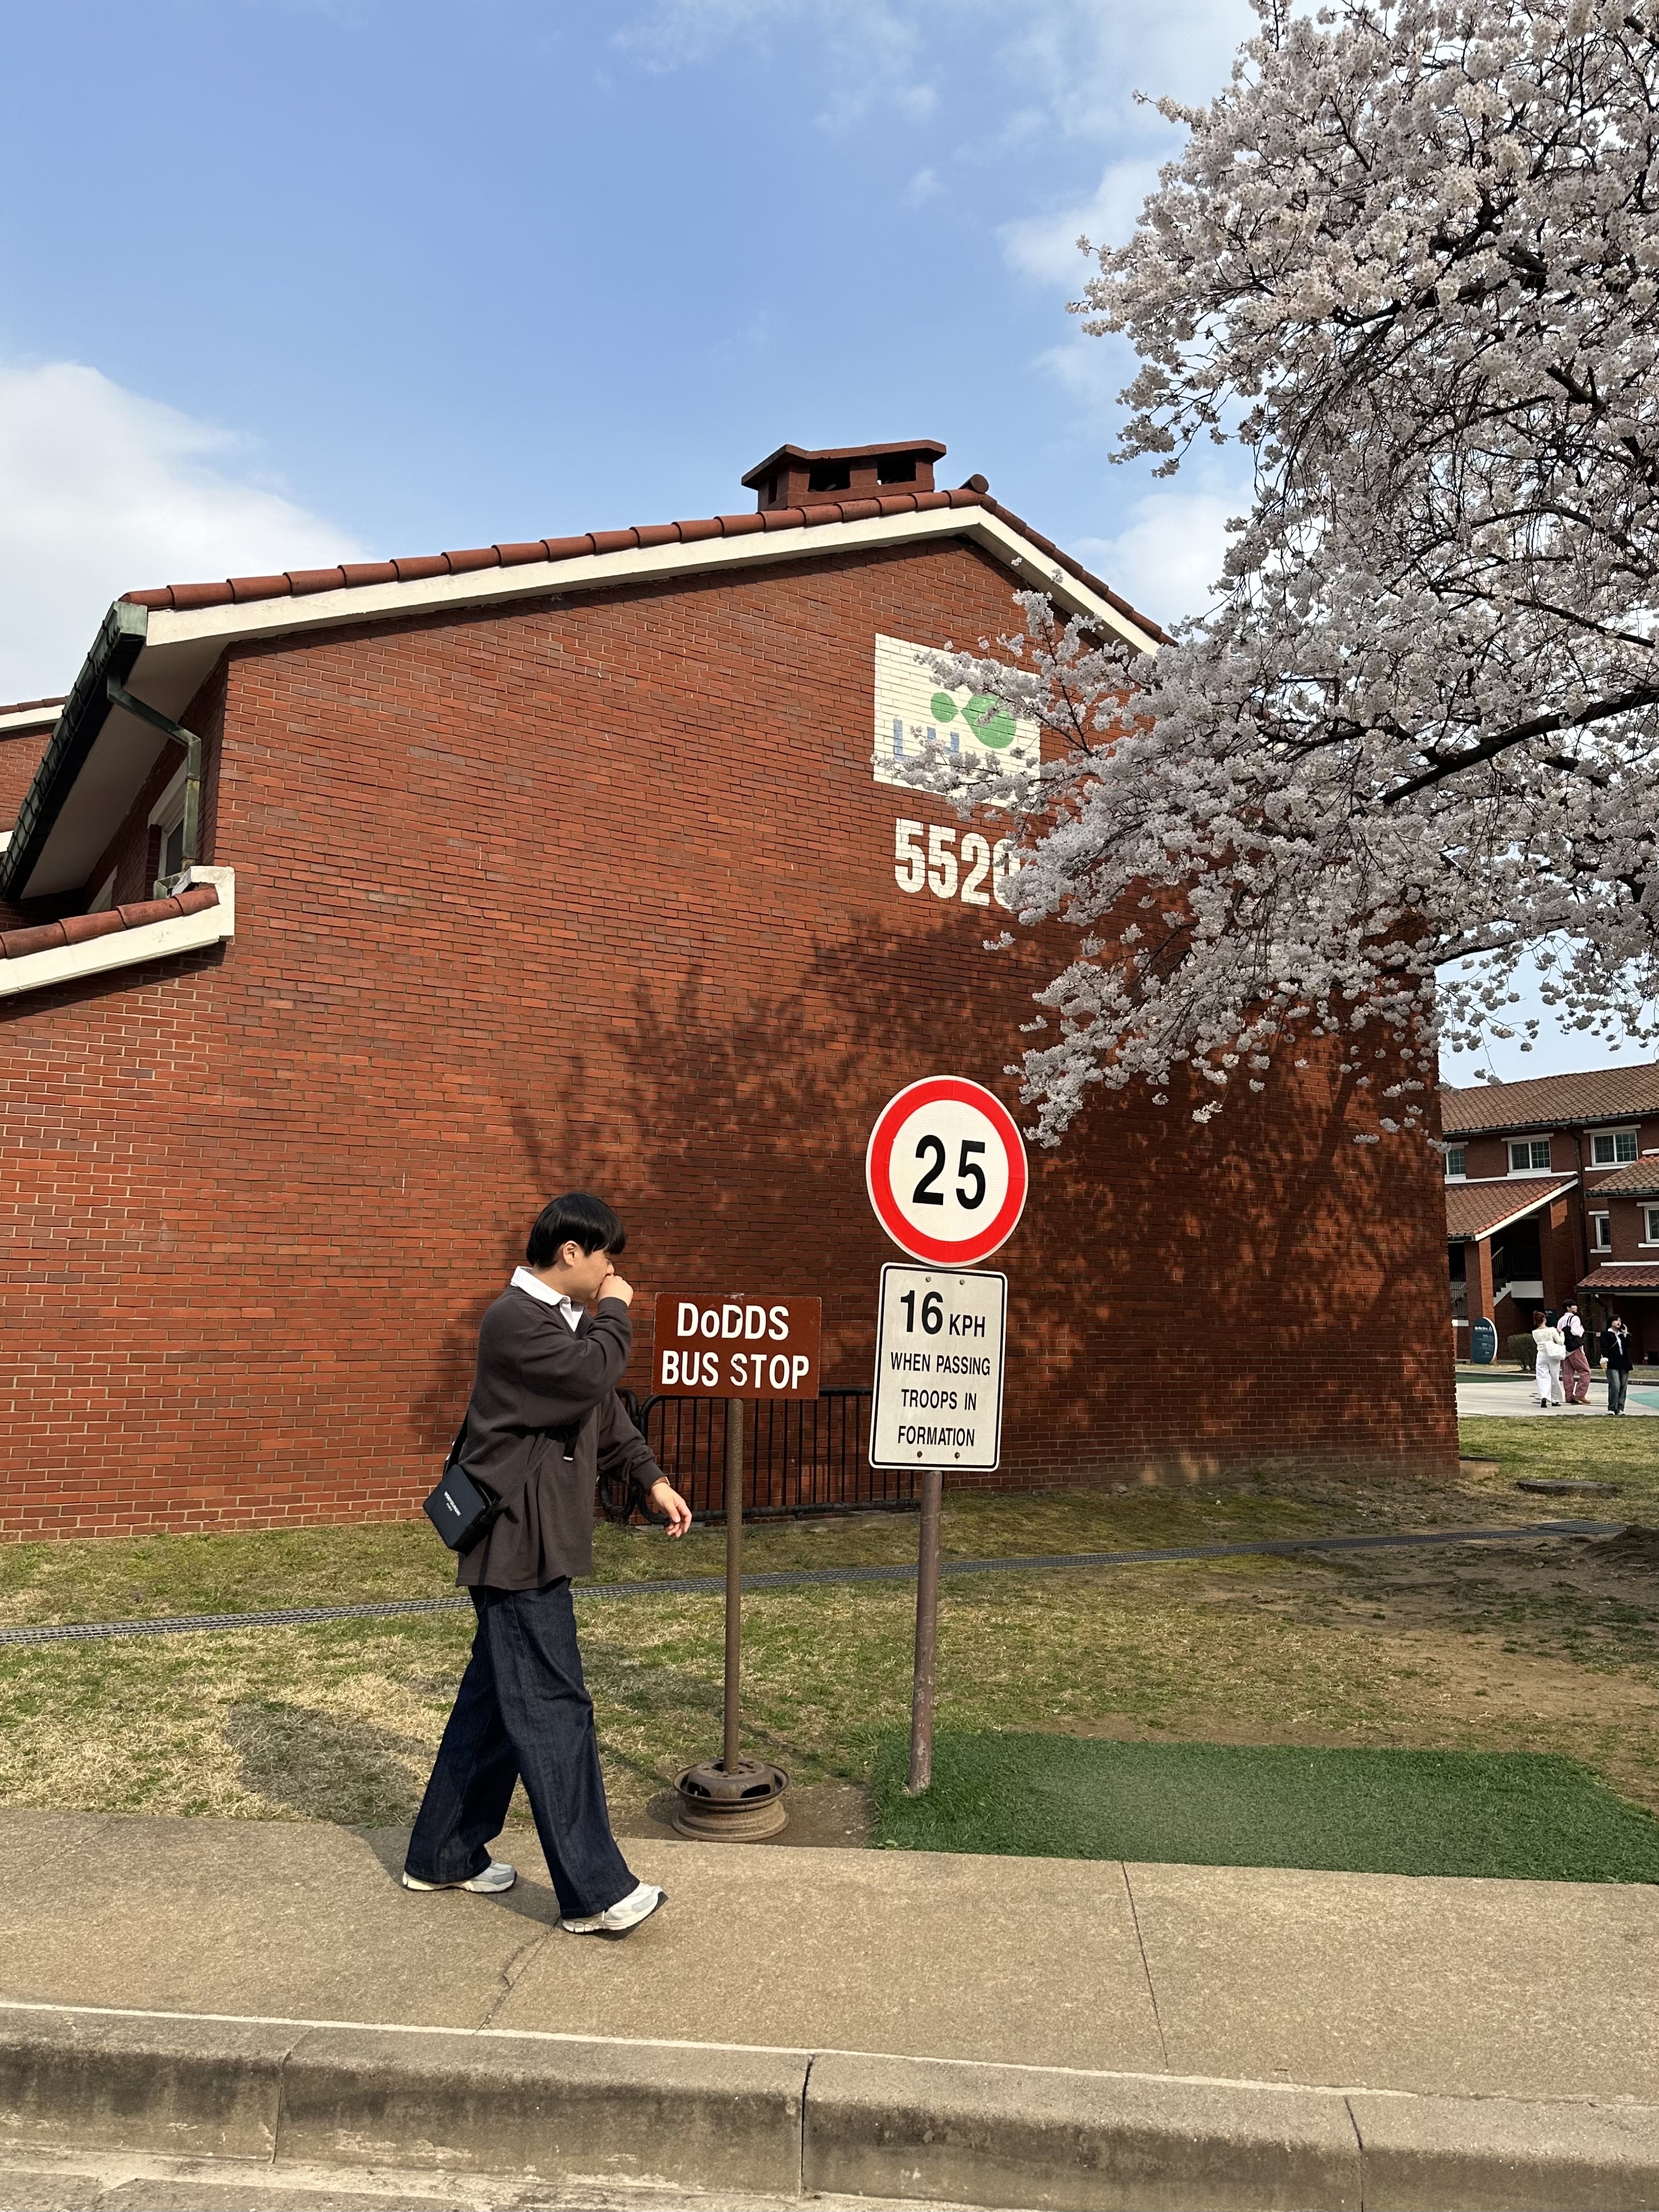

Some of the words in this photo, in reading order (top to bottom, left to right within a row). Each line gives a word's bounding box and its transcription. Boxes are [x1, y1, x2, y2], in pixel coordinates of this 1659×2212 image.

[913, 1135, 985, 1209] 25
[677, 1302, 789, 1341] DoDDS
[900, 1290, 944, 1334] 16
[949, 1314, 985, 1337] KPH
[662, 1350, 719, 1387] BUS
[730, 1353, 809, 1389] STOP
[891, 1352, 930, 1372] WHEN
[936, 1354, 991, 1376] PASSING
[901, 1389, 957, 1410] TROOPS
[965, 1392, 977, 1411] IN
[898, 1425, 975, 1447] FORMATION
